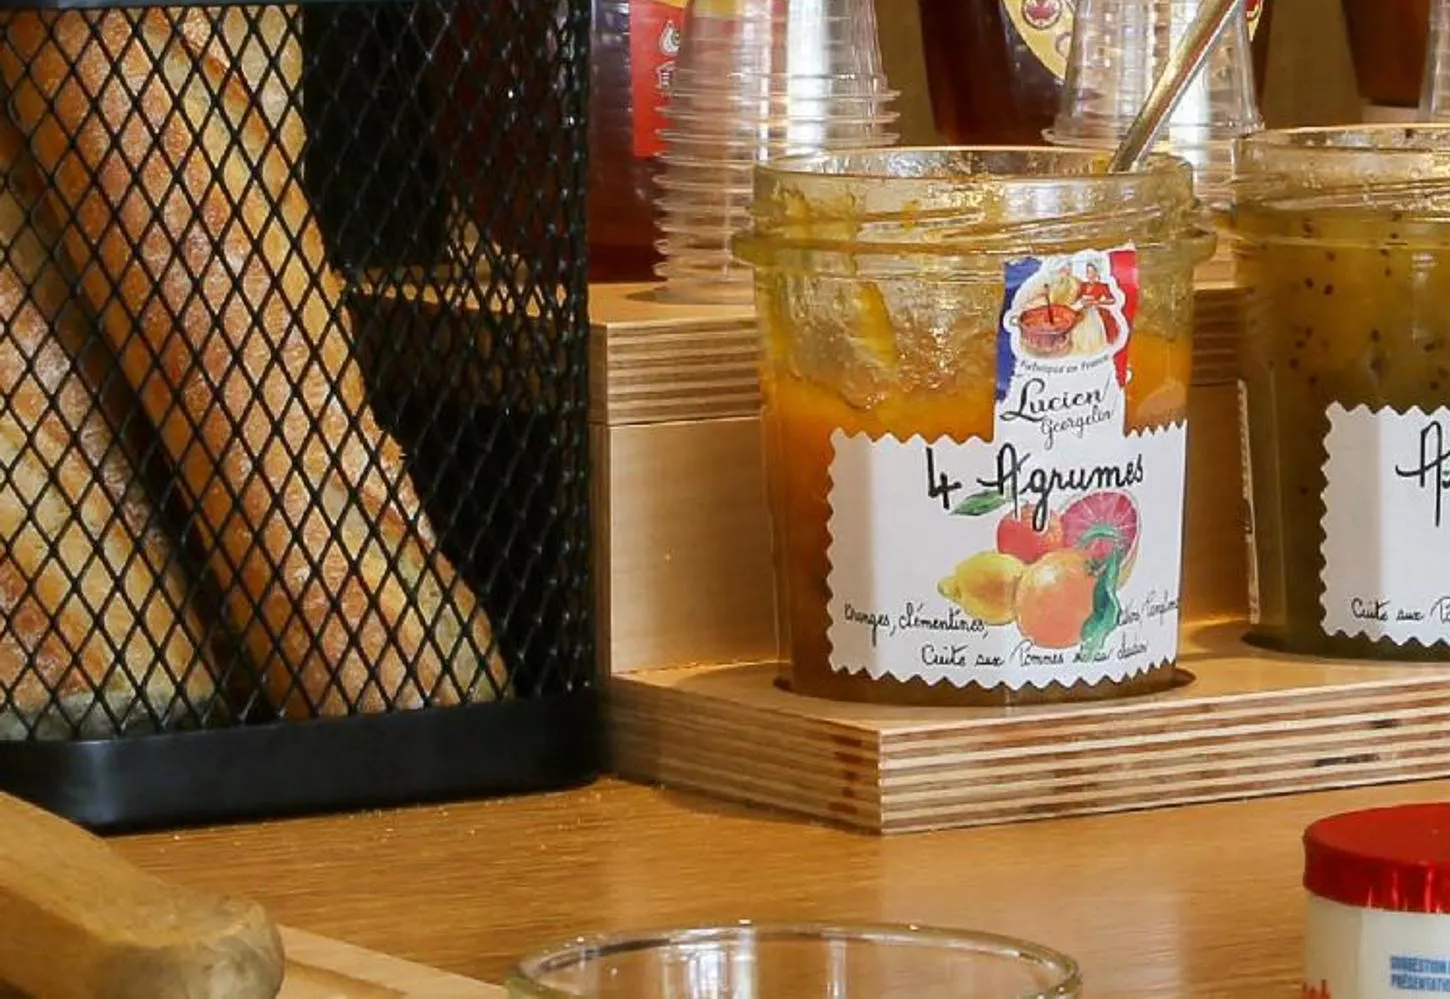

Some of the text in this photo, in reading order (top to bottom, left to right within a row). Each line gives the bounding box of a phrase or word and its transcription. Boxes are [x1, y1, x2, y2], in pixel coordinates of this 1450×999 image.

[1000, 377, 1103, 422] Lucien
[1041, 404, 1111, 450] Georgelin
[926, 443, 1144, 532] 4 Agrumes
